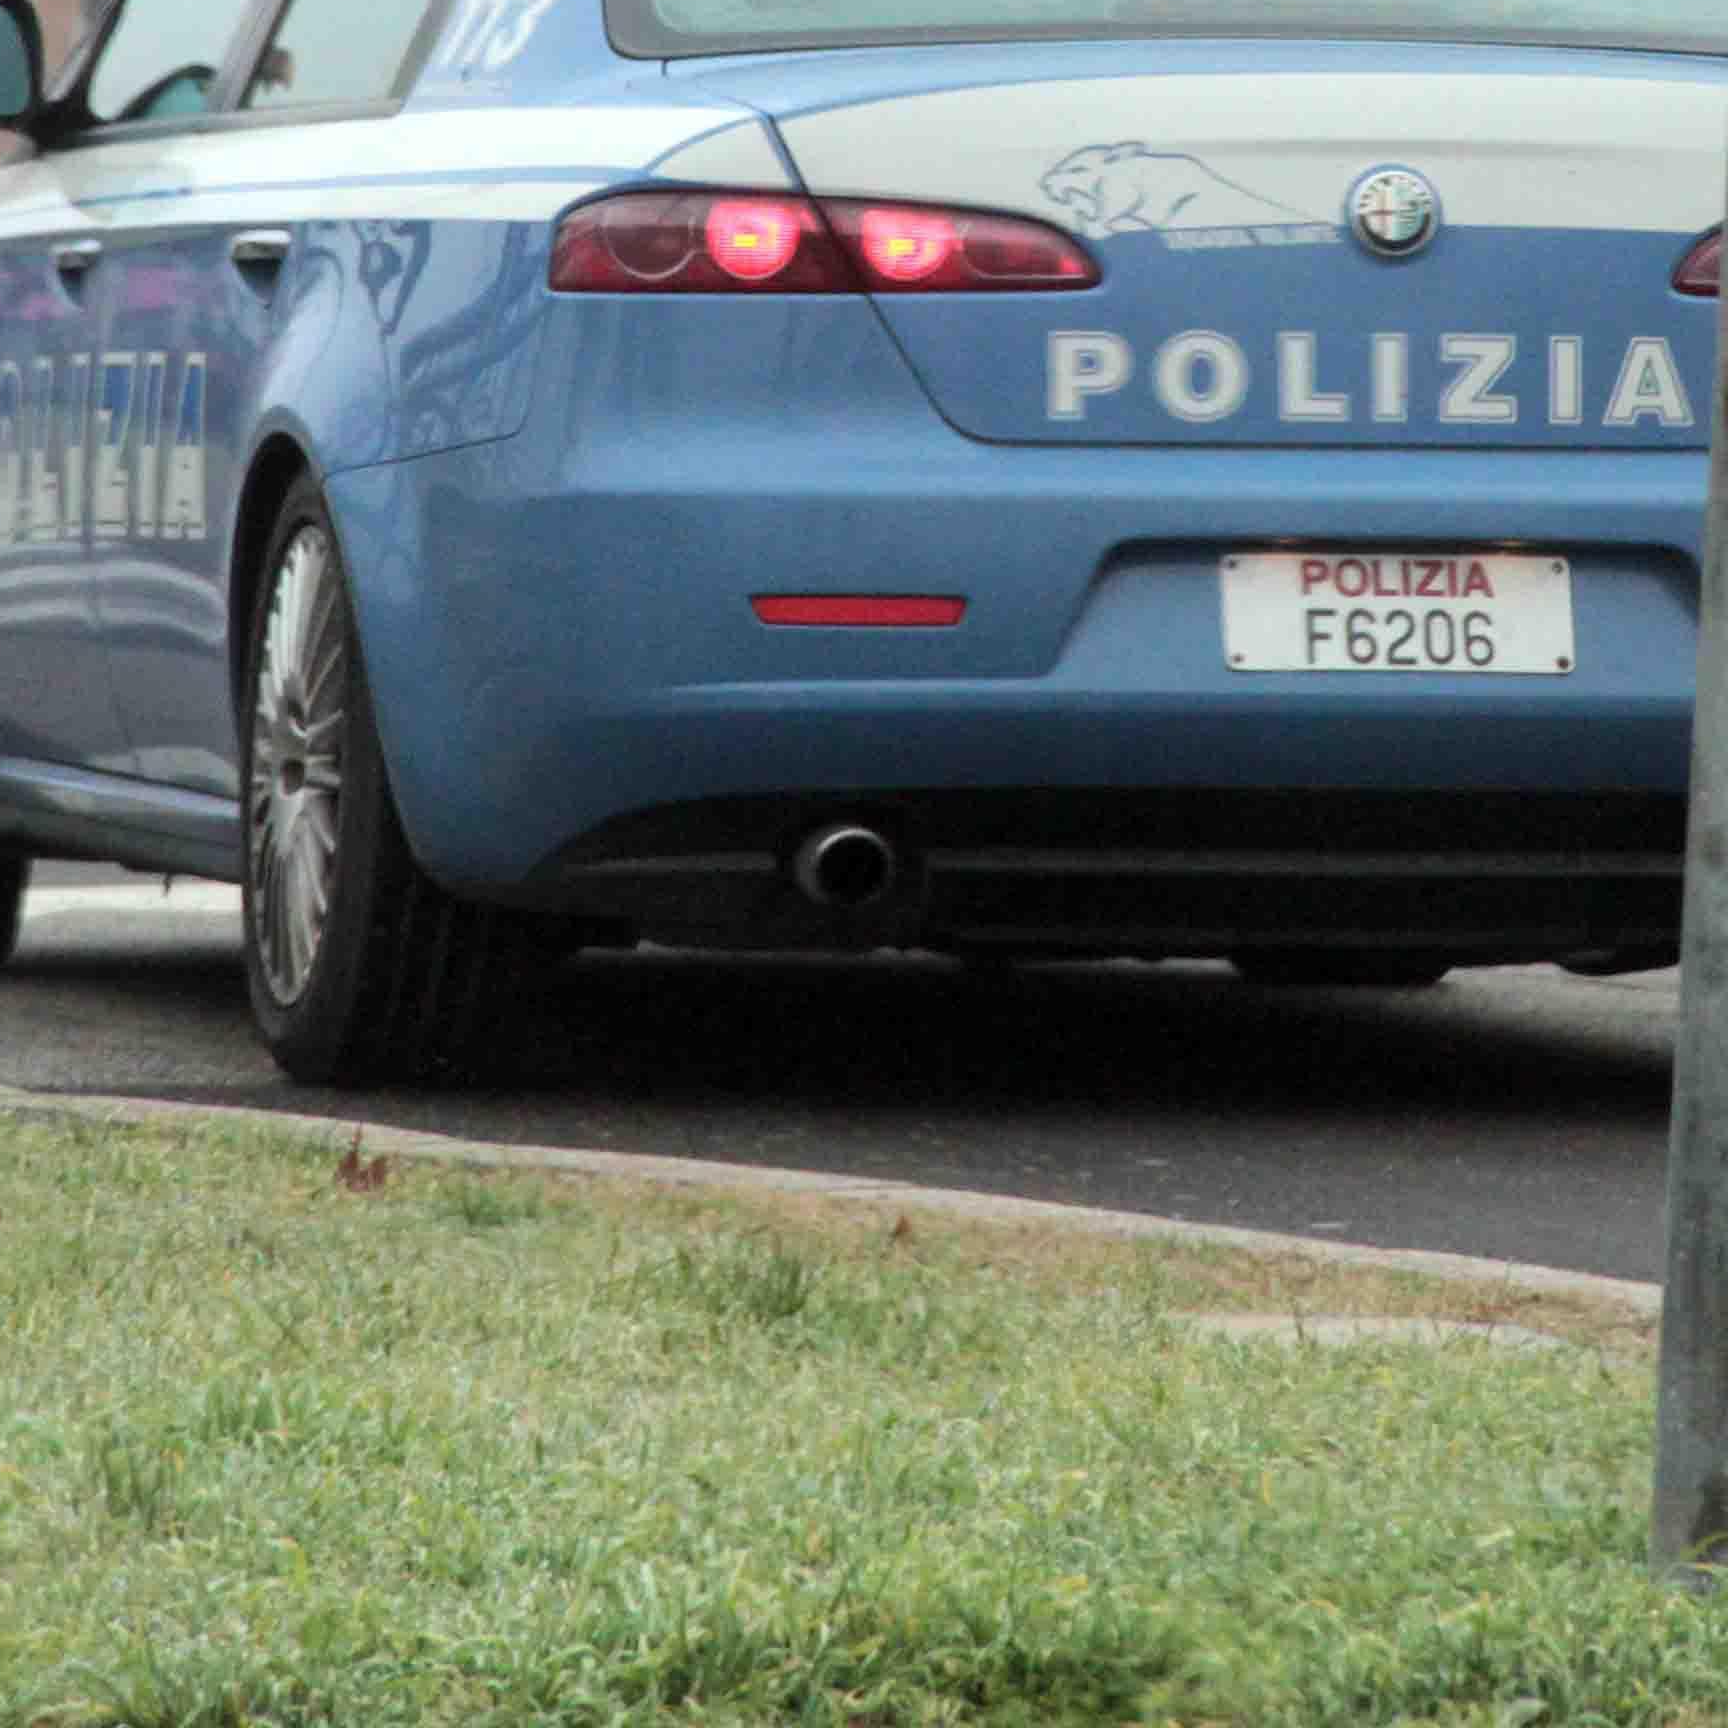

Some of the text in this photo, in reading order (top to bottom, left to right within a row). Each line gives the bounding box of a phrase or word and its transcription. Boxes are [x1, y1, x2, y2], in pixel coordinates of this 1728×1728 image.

[1046, 329, 1695, 426] POLIZIA
[1300, 558, 1494, 597] POLIZIA
[1304, 608, 1495, 666] F6206
